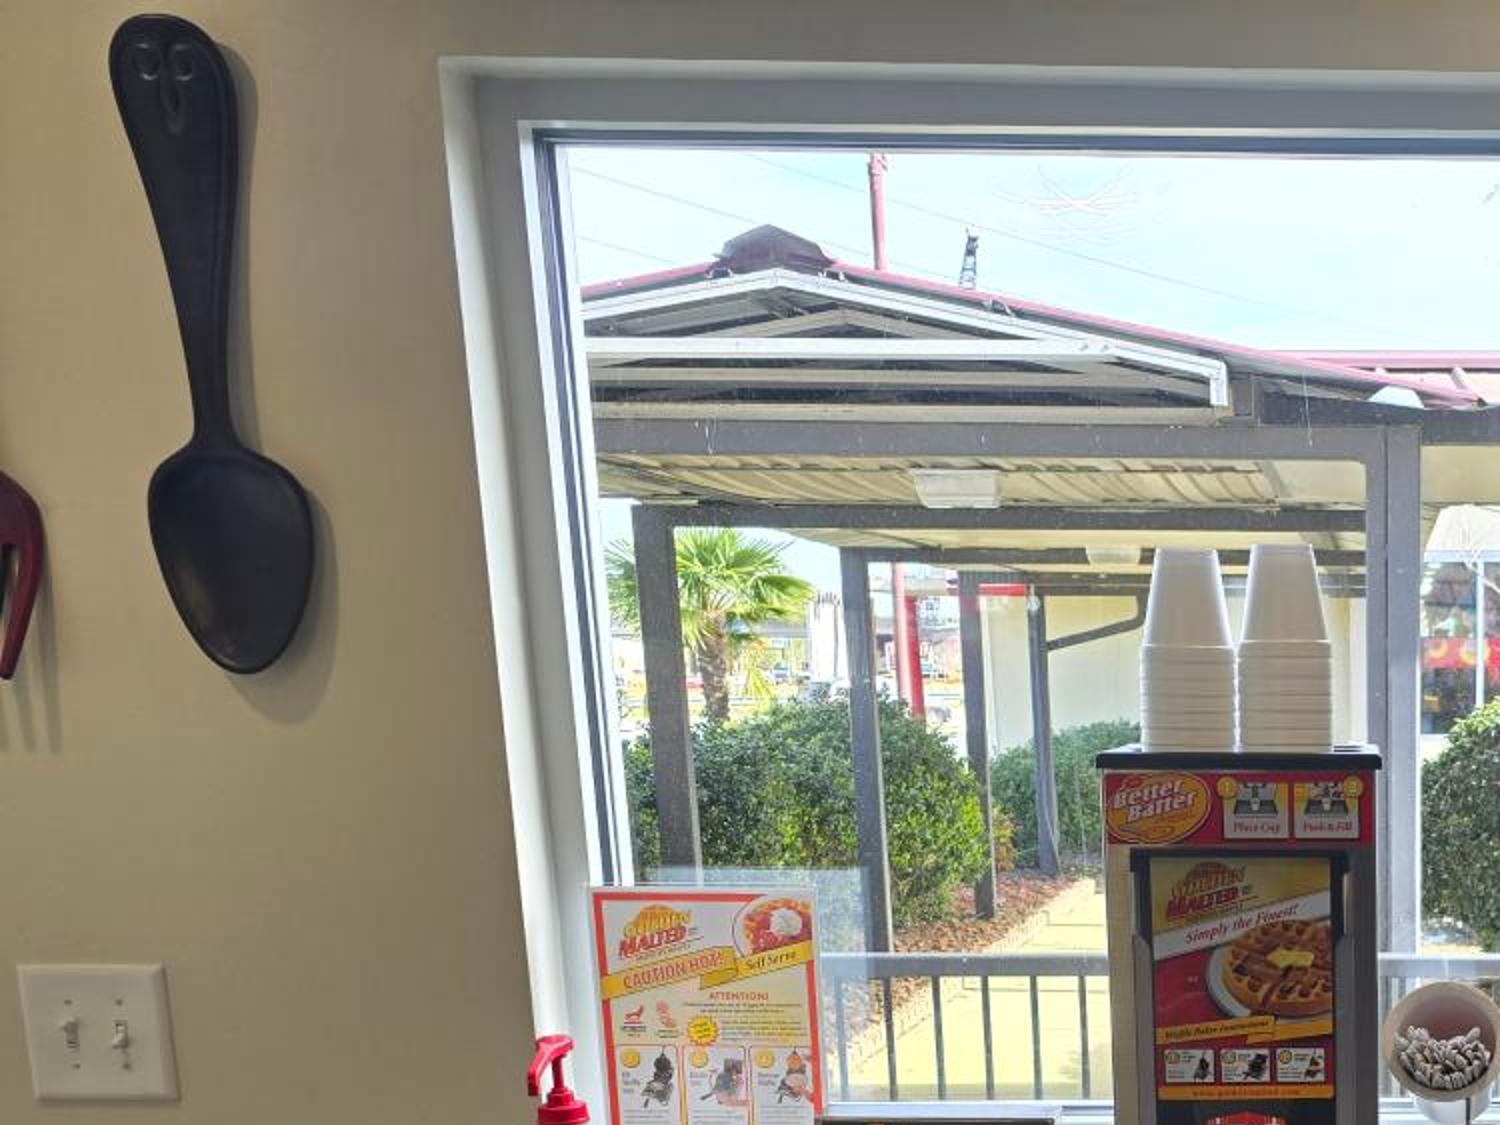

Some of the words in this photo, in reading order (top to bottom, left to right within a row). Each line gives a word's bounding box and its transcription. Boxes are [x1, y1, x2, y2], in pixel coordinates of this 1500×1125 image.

[1113, 779, 1184, 809] Better
[1128, 794, 1196, 820] Batter
[1184, 923, 1229, 944] Simply
[1232, 914, 1254, 930] the
[1255, 904, 1299, 926] Finest!
[623, 962, 688, 989] CAUTION
[690, 951, 725, 975] HOT!
[745, 955, 767, 972] Self
[768, 949, 796, 966] Serve
[709, 992, 769, 1001] ATTENTION!
